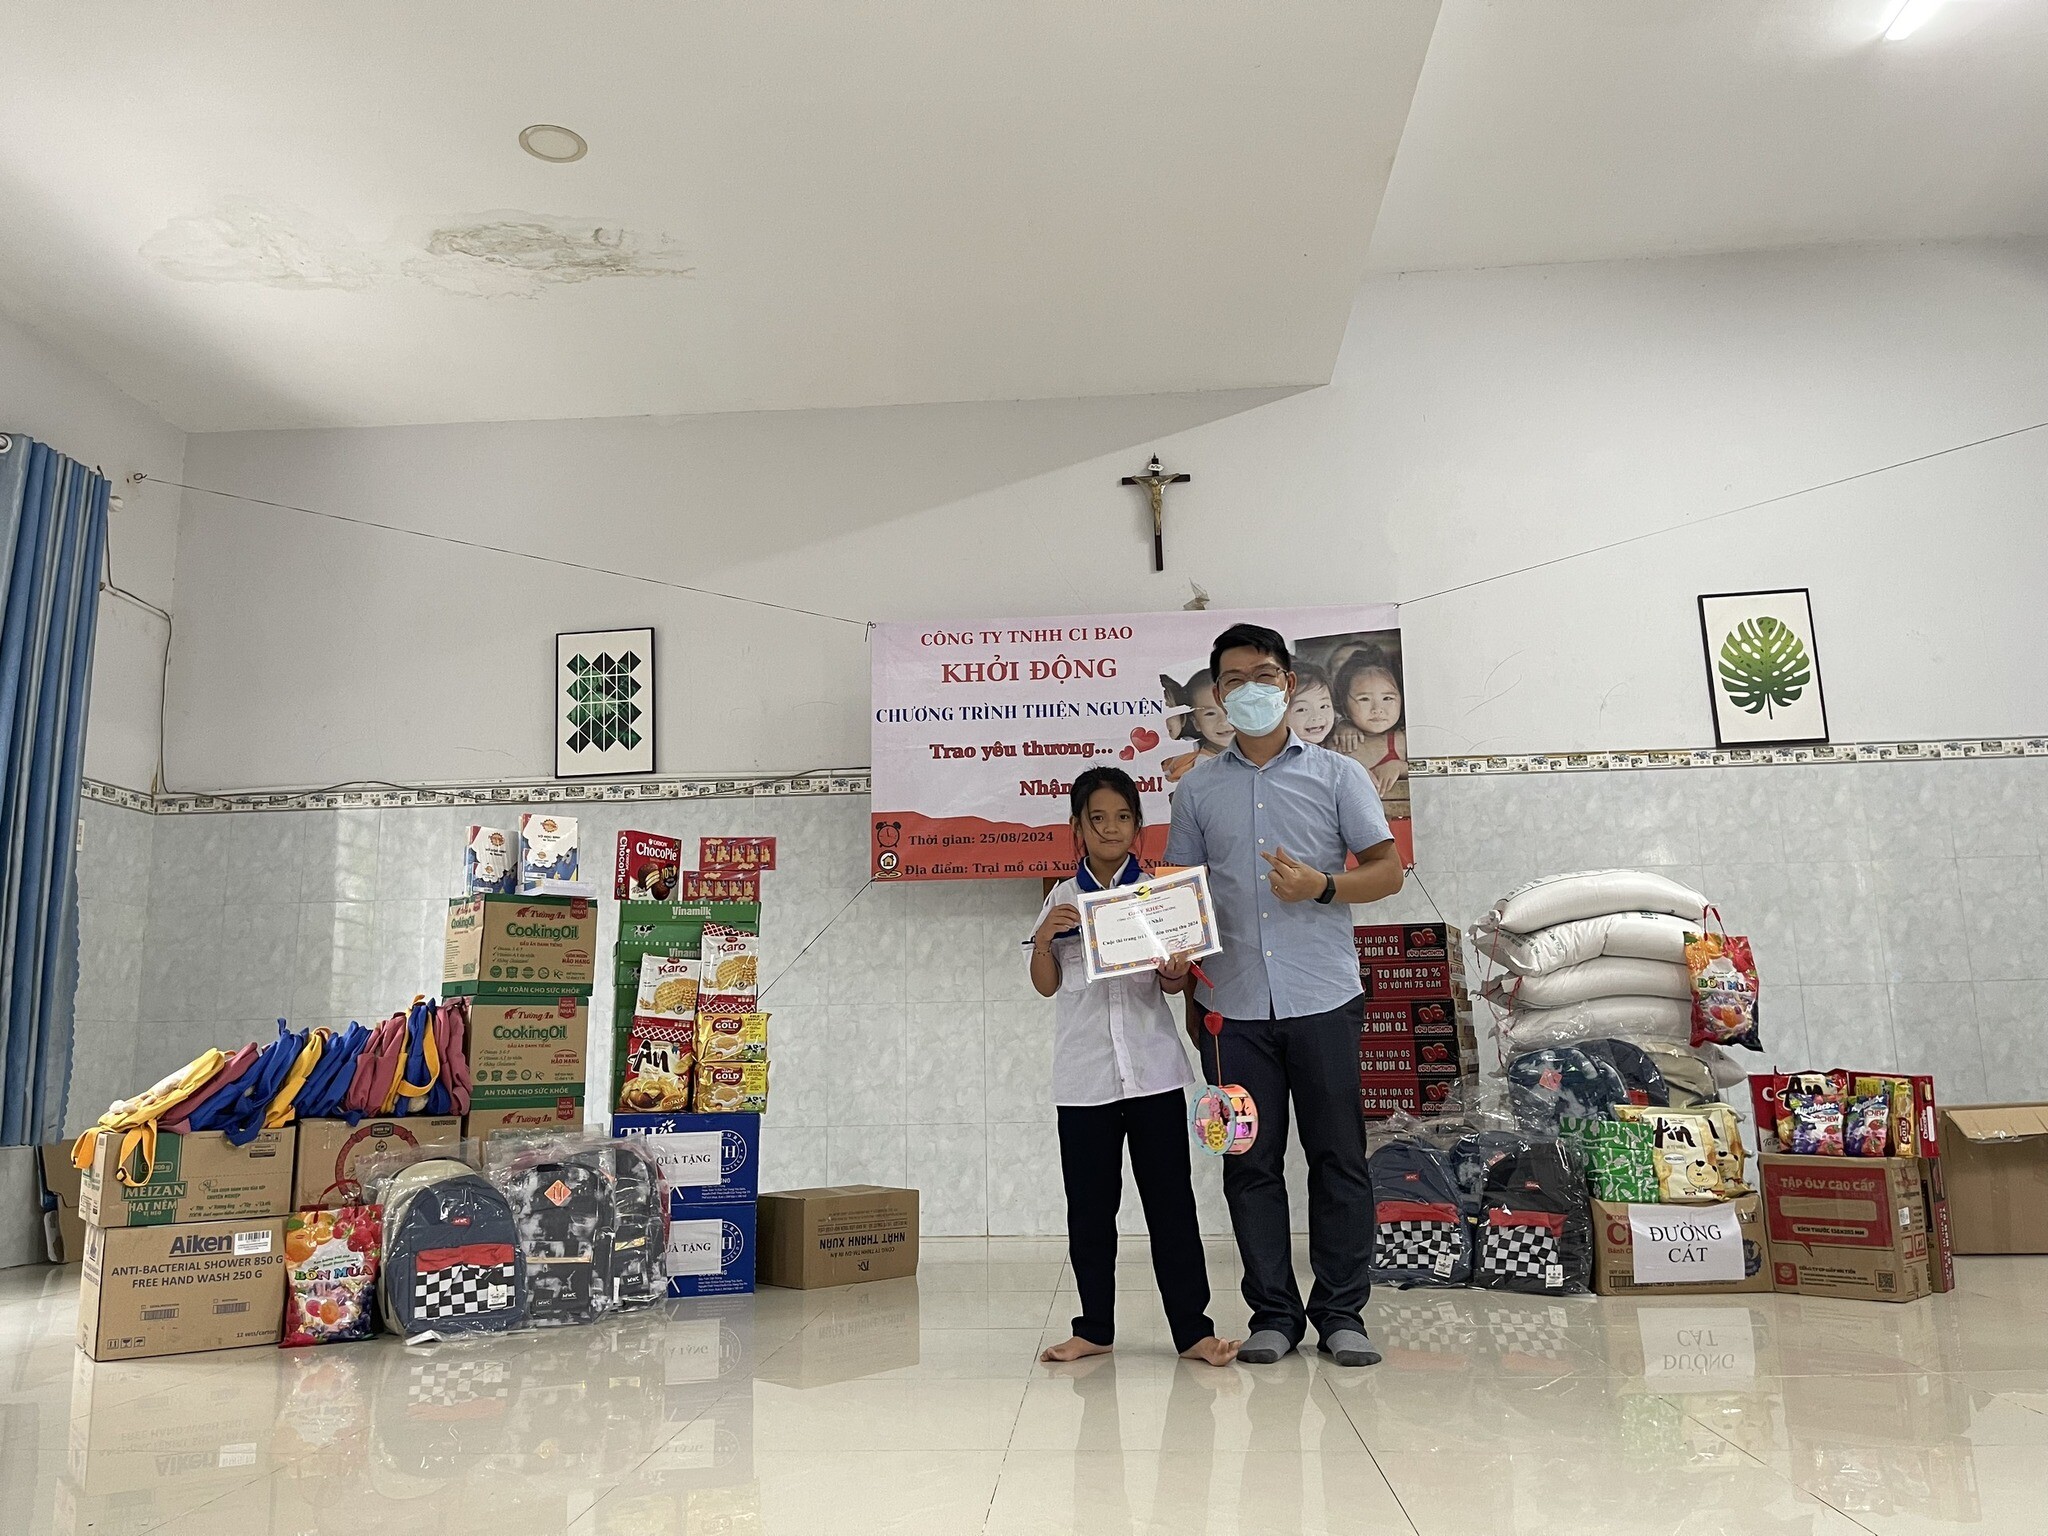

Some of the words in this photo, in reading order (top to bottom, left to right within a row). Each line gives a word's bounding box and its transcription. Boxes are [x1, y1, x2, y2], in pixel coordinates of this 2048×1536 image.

[921, 630, 974, 647] CÔNG
[979, 631, 1003, 645] TY
[1007, 629, 1063, 643] TNHH
[1068, 628, 1088, 642] CI
[1094, 626, 1134, 640] BAO
[941, 655, 1020, 683] KHỞI
[1029, 654, 1118, 684] ĐỘNG
[876, 705, 954, 723] CHƯƠNG
[959, 702, 1017, 721] TRÌNH
[1023, 701, 1081, 720] THIỆN
[1086, 698, 1164, 718] NGUYỆN
[929, 744, 977, 759] Trao
[980, 741, 1016, 763] yêu
[1022, 740, 1113, 760] thương...
[1019, 778, 1072, 798] Nhận
[908, 834, 940, 847] Thời
[943, 834, 976, 848] gian:
[979, 831, 1054, 845] 25/08/2024
[636, 842, 678, 861] ChocoPie
[904, 863, 928, 876] Địa
[931, 861, 968, 876] điểm:
[972, 861, 1000, 875] Trại
[1028, 859, 1048, 871] côi
[672, 906, 712, 917] Vinamilk
[1364, 935, 1373, 944] MÌ
[1375, 935, 1388, 945] VỚI
[1389, 935, 1399, 943] SO
[1410, 928, 1437, 947] 90
[717, 943, 747, 953] Karo
[1364, 946, 1385, 957] HƠN
[1387, 946, 1400, 956] TO
[658, 964, 688, 976] Karo
[1377, 969, 1390, 979] TO
[1393, 967, 1413, 979] HƠN
[1415, 969, 1429, 978] 20
[1431, 968, 1441, 977] %
[546, 985, 560, 994] SỨC
[1378, 982, 1388, 990] SO
[1390, 980, 1402, 990] VỚI
[1404, 980, 1413, 989] MÌ
[1414, 981, 1424, 989] 75
[1426, 981, 1442, 989] GAM
[1372, 1011, 1381, 1020] MÌ
[1382, 1011, 1395, 1020] VỚI
[1397, 1011, 1407, 1019] SO
[1418, 1004, 1445, 1024] 90
[1373, 1023, 1392, 1034] HƠN
[1394, 1023, 1408, 1032] TO
[1376, 1050, 1385, 1059] MÌ
[1386, 1050, 1398, 1059] VỚI
[1400, 1050, 1410, 1058] SO
[1421, 1043, 1449, 1063] 90
[1361, 1061, 1374, 1071] 20
[1376, 1060, 1396, 1071] HƠN
[1398, 1060, 1411, 1070] TO
[497, 1087, 517, 1096] TOÀN
[534, 1086, 549, 1095] SỨC
[1379, 1088, 1388, 1097] MÌ
[1390, 1088, 1402, 1097] VỚI
[1404, 1088, 1414, 1096] SO
[1364, 1099, 1377, 1109] 20
[1379, 1099, 1399, 1110] HƠN
[1402, 1099, 1415, 1109] TO
[1901, 1119, 1910, 1143] GOLD
[656, 1154, 679, 1166] QUÀ
[681, 1154, 711, 1165] TẶNG
[1780, 1176, 1803, 1191] TẬP
[125, 1184, 184, 1198] MEIZAN
[128, 1201, 150, 1214] HẠT
[153, 1199, 177, 1210] NÊM
[1649, 1222, 1722, 1242] ĐƯỜNG
[169, 1234, 233, 1255] Aiken
[681, 1243, 711, 1254] TẶNG
[819, 1237, 845, 1251] XUÂN
[1668, 1244, 1708, 1263] CÁT
[111, 1262, 202, 1277] ANTI-BACTERIAL
[203, 1258, 252, 1270] SHOWER
[254, 1256, 274, 1267] 850
[275, 1254, 284, 1264] G
[294, 1265, 331, 1281] BỐN
[334, 1263, 374, 1279] MÙA
[132, 1277, 158, 1289] FREE
[161, 1275, 194, 1287] HAND
[197, 1272, 231, 1284] WASH
[233, 1271, 252, 1281] 250
[254, 1269, 263, 1279] G
